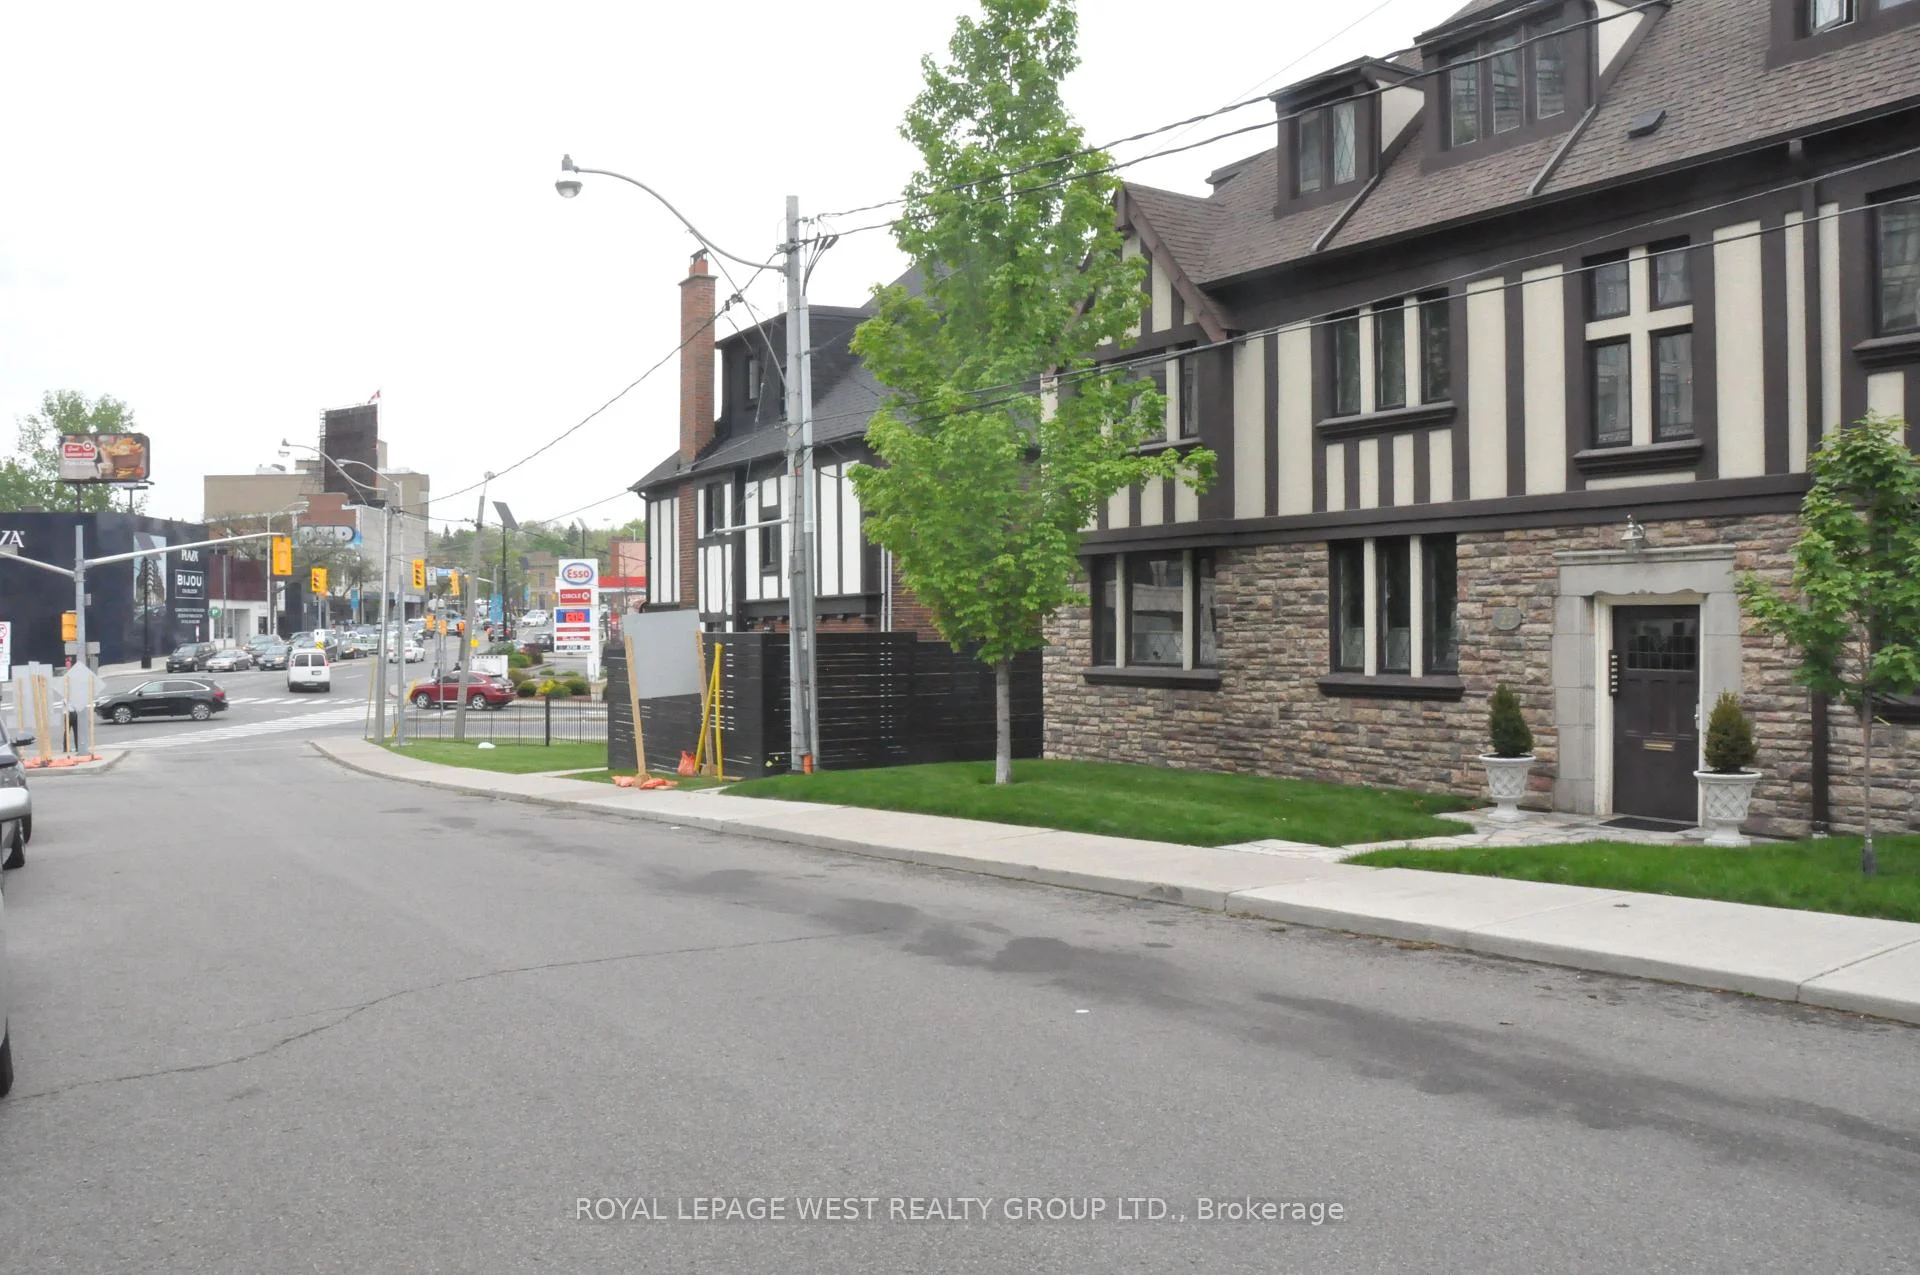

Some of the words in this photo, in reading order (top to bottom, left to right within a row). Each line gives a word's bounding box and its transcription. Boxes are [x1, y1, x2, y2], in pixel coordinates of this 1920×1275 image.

[567, 568, 590, 579] Esso
[177, 574, 202, 587] BIJOU
[561, 592, 581, 600] CIRCLE
